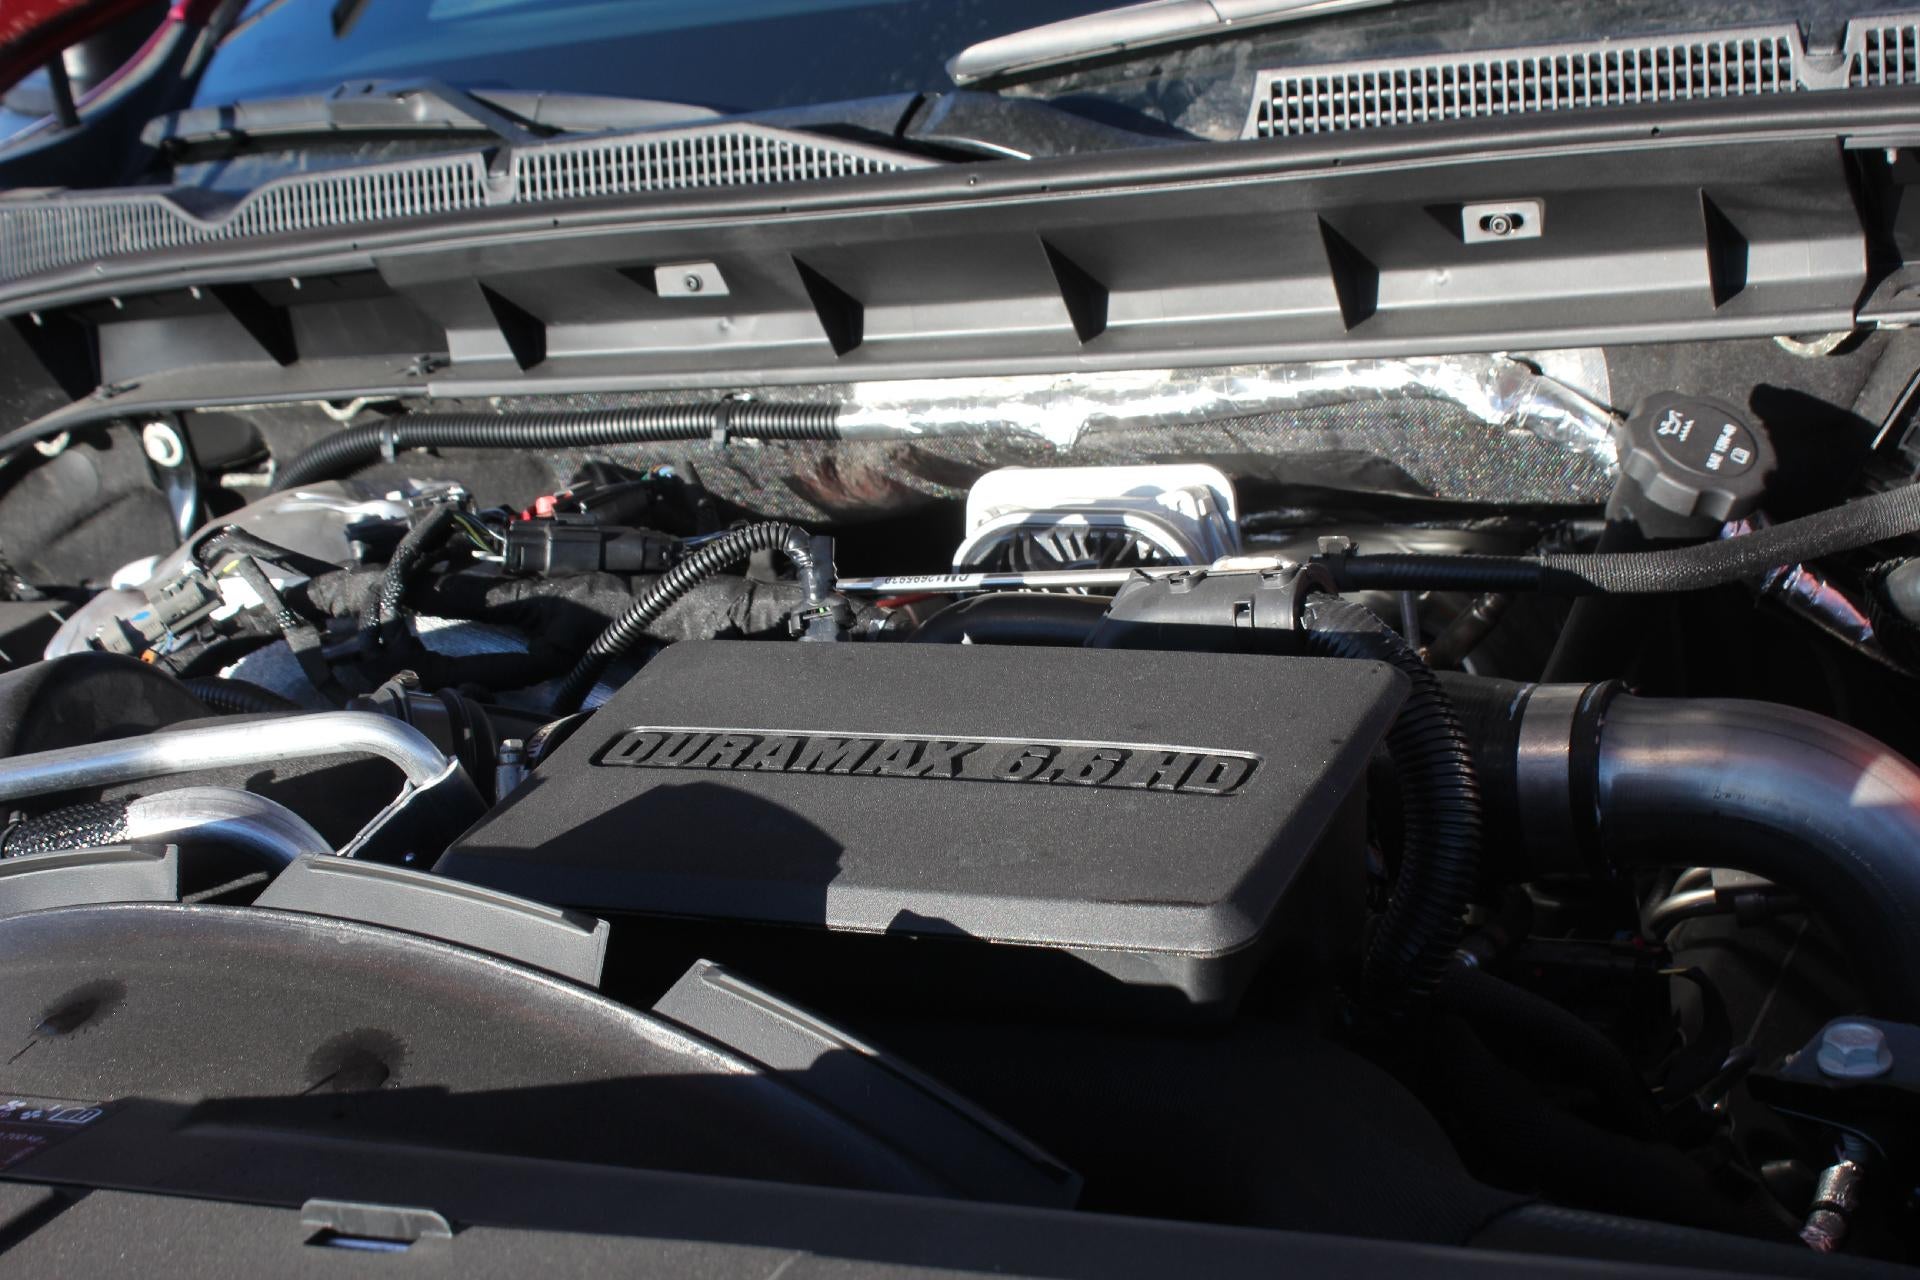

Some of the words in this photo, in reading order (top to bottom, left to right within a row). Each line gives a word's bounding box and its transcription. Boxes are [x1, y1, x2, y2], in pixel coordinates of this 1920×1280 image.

[601, 731, 984, 778] DURAMAX
[992, 743, 1128, 785] 6.6
[1129, 750, 1252, 794] HD
